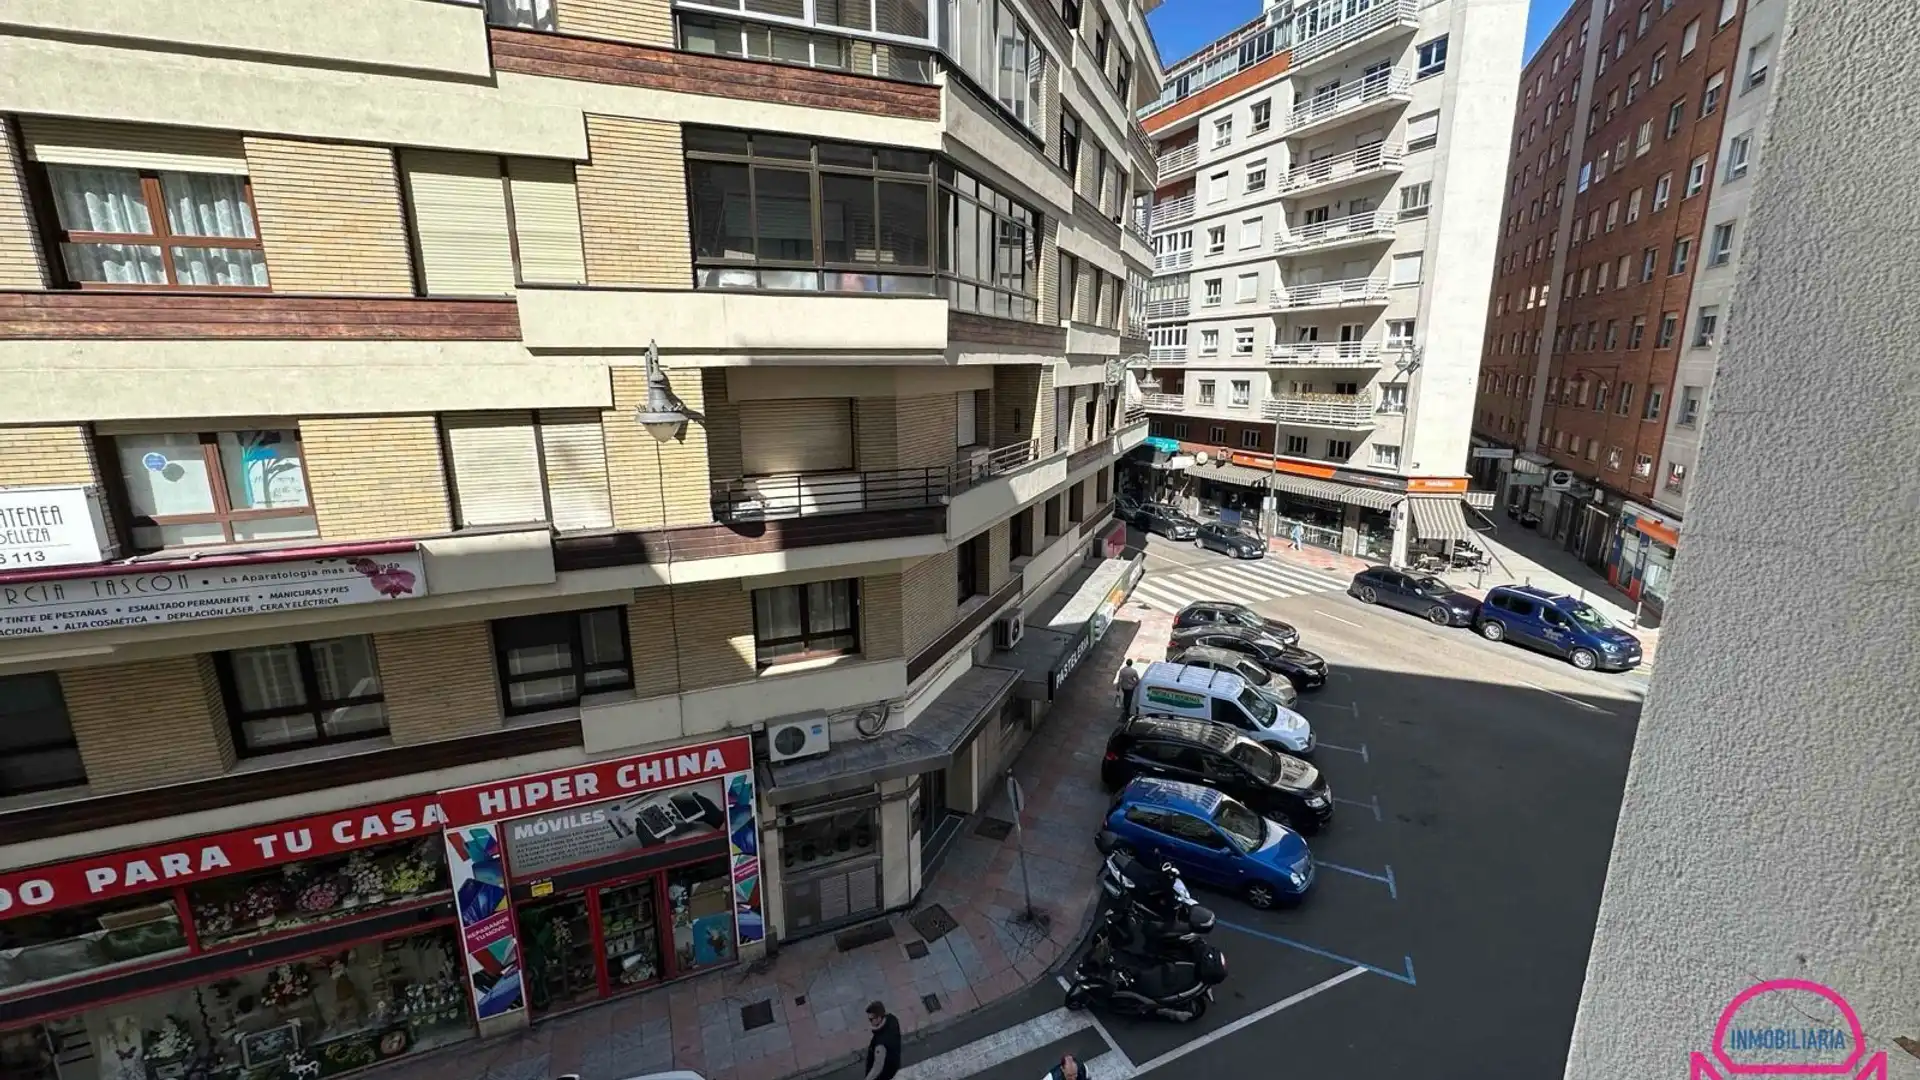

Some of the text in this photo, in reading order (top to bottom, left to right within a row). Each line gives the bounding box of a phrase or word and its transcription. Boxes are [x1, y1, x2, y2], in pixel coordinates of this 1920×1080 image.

[12, 550, 46, 563] 113
[6, 614, 36, 624] TINTE
[40, 613, 53, 621] DE
[56, 607, 108, 619] PESTAÑAS
[128, 600, 186, 613] ESMALTADO
[187, 595, 250, 608] PERMANENTE
[270, 587, 322, 600] MANICURAS
[330, 586, 349, 594] PIES
[64, 622, 89, 631] ALTA
[260, 602, 284, 611] CERA
[478, 748, 727, 816] HIPER CHINA
[514, 809, 606, 840] MÓVILES
[84, 845, 231, 894] PARA
[253, 828, 312, 859] TU
[332, 803, 449, 843] CASA
